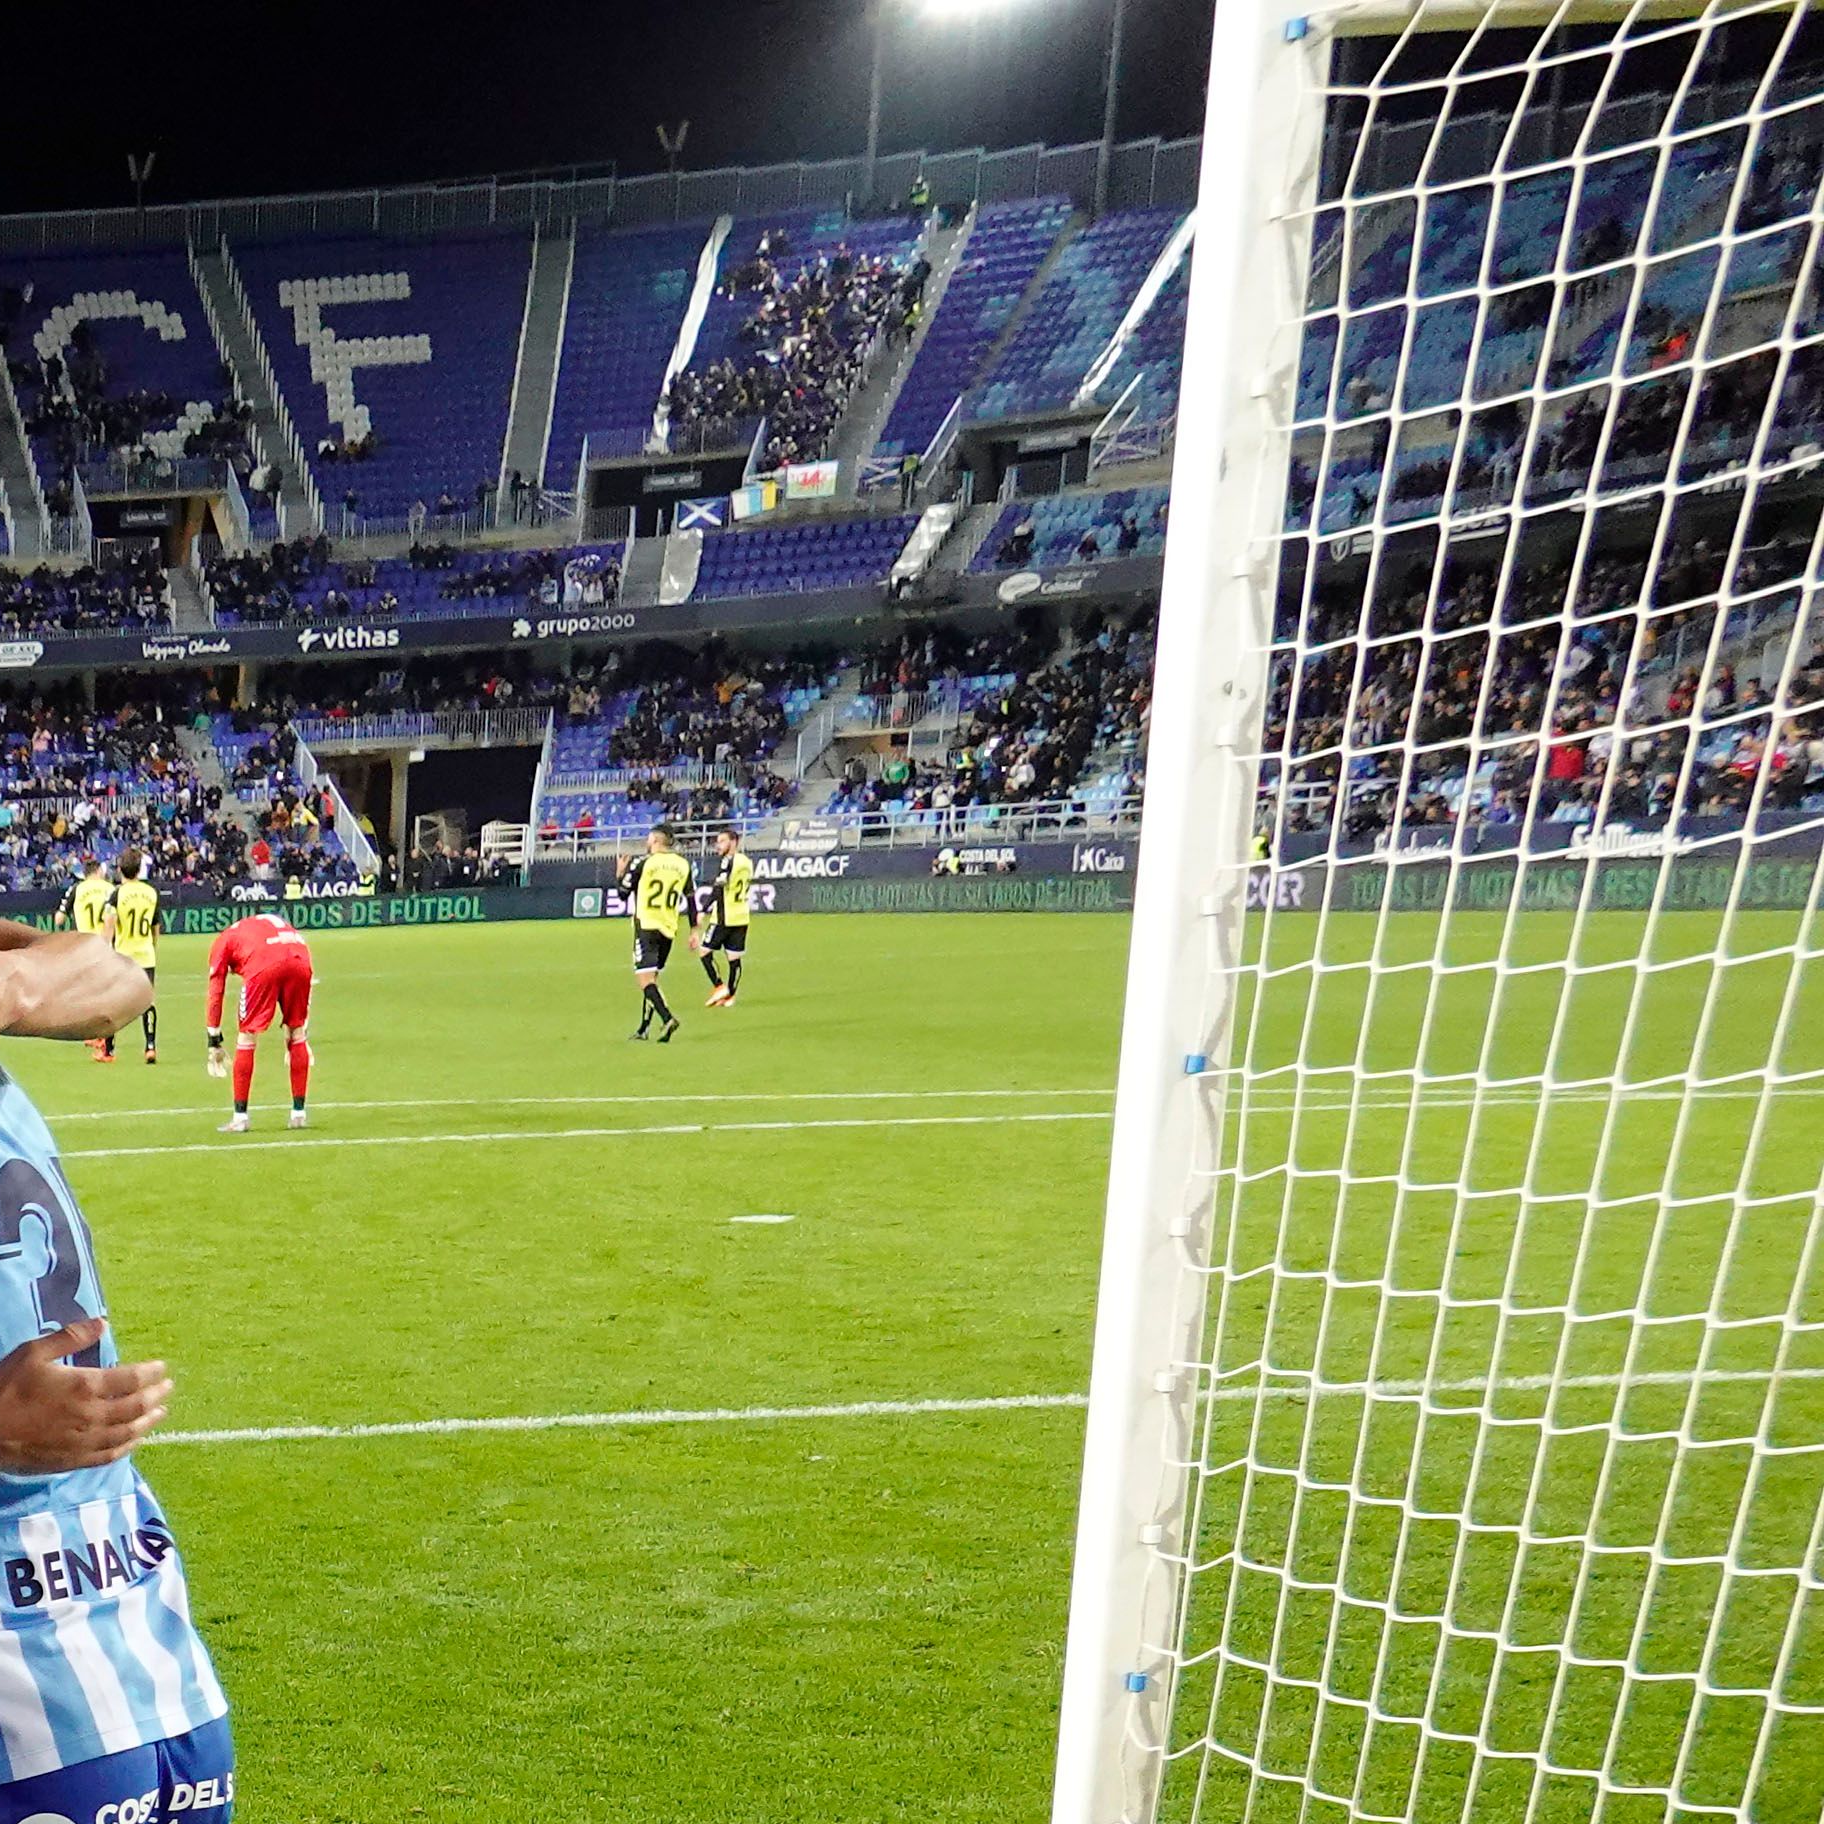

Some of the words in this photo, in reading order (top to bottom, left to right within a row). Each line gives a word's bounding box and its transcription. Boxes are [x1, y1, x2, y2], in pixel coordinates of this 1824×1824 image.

[322, 625, 400, 650] vithas
[537, 613, 635, 638] grupo2000
[647, 879, 680, 910] 26
[127, 907, 151, 937] 16
[161, 908, 177, 933] Y
[350, 901, 382, 926] DE
[389, 894, 486, 923] FÚTBOL
[168, 1778, 225, 1812] DEL
